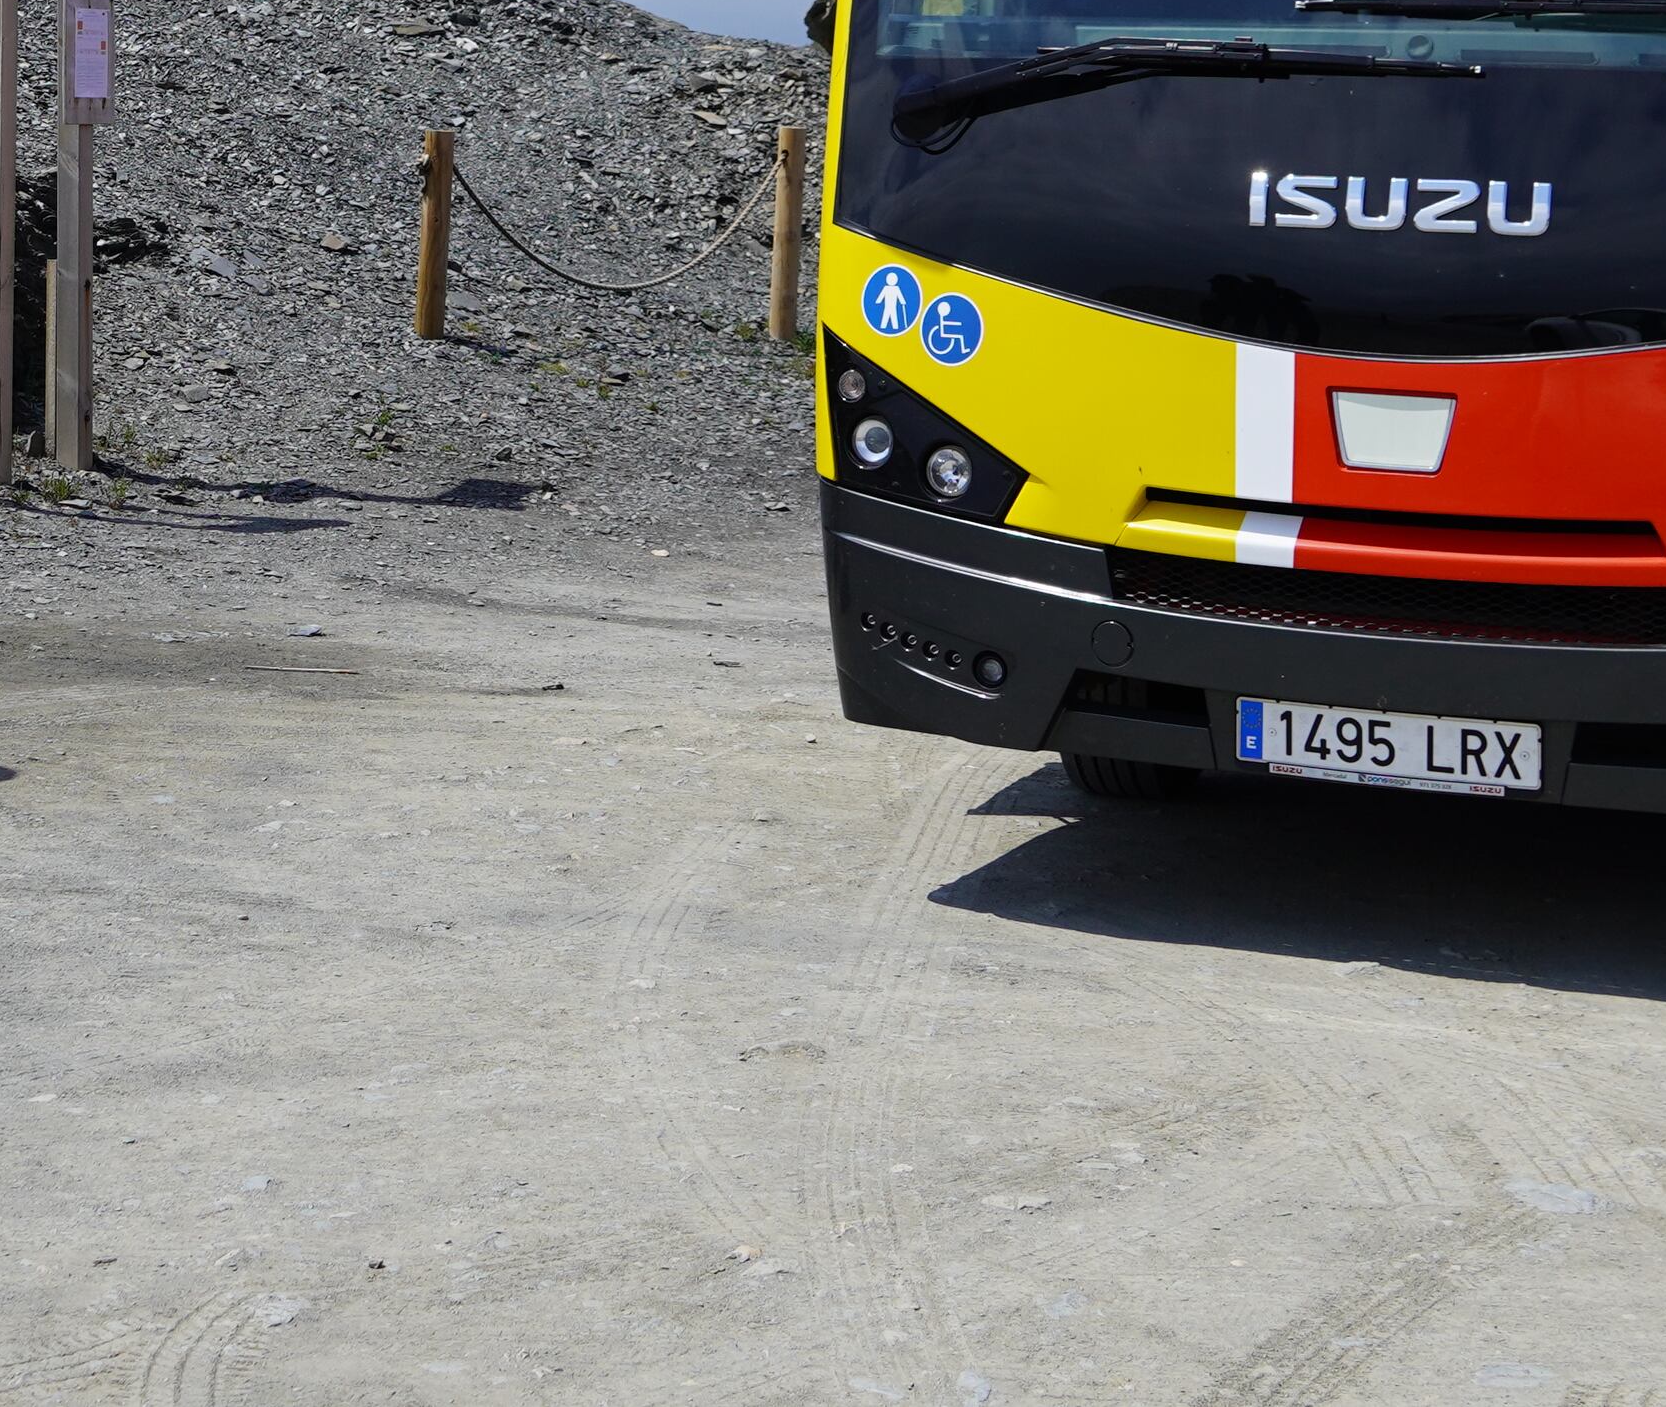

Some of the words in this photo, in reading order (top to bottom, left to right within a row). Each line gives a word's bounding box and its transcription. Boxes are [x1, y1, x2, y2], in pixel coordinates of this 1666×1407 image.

[1248, 170, 1553, 237] ISUZU
[1245, 735, 1258, 750] E
[1279, 709, 1396, 768] 1495
[1426, 724, 1522, 781] LRX
[1272, 765, 1303, 775] ISUZU
[1469, 784, 1502, 795] ISUZU
